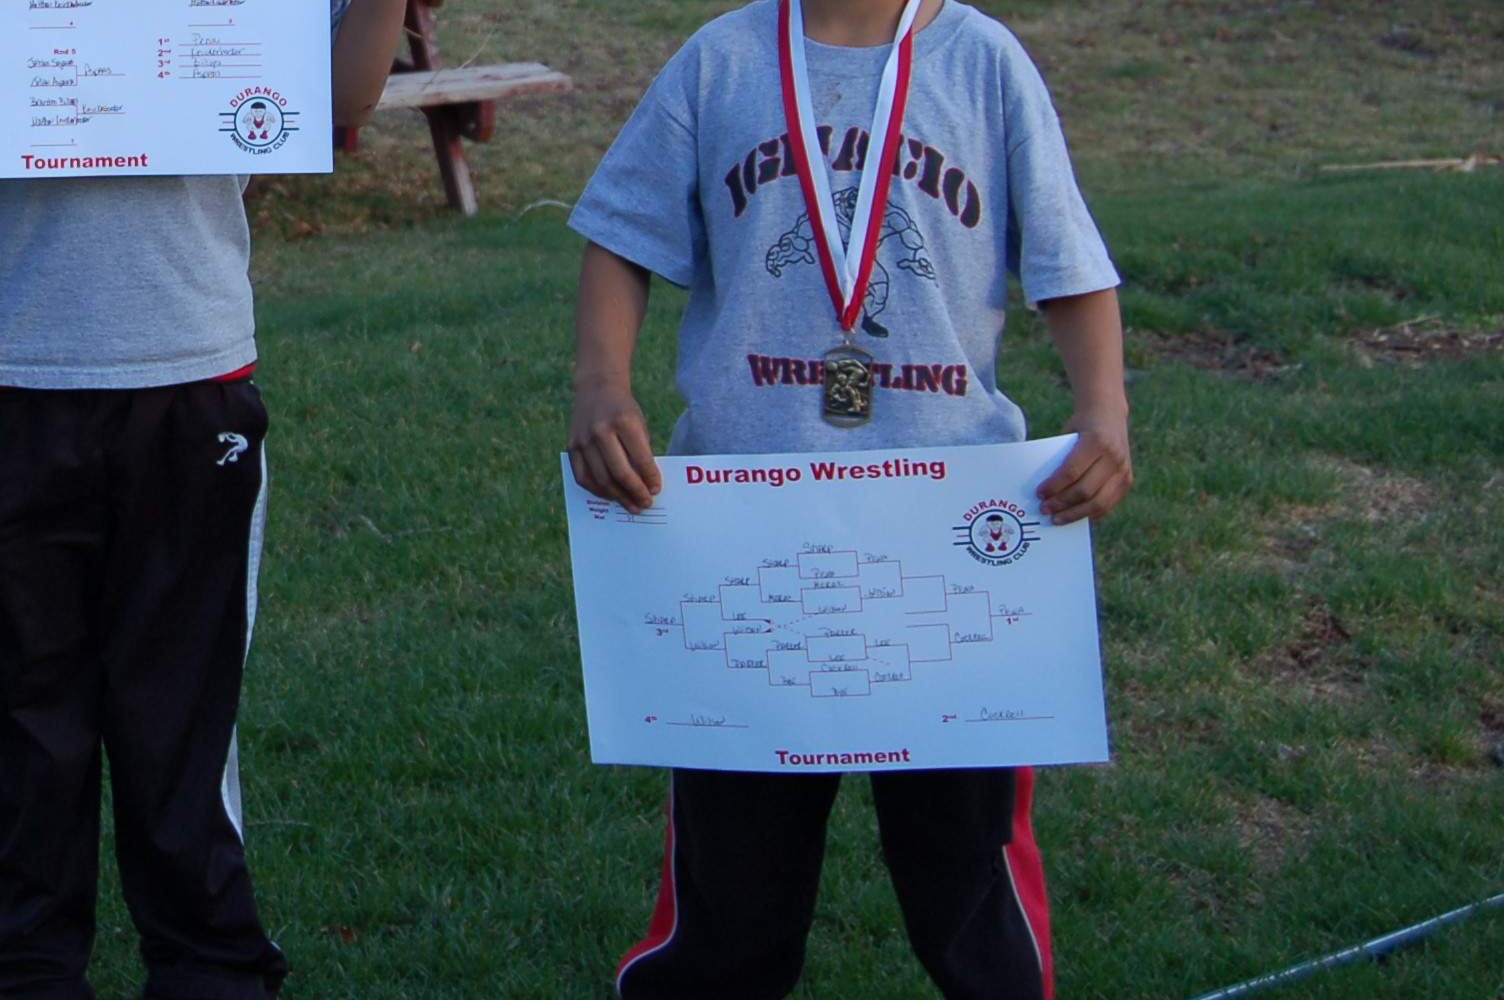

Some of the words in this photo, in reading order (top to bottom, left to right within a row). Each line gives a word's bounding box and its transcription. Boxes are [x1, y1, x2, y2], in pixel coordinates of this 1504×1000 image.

[229, 86, 287, 108] DURANGO
[272, 131, 290, 150] CLUB
[21, 153, 148, 169] Tournament
[747, 354, 968, 397] WRETLING
[686, 465, 802, 487] Durango
[810, 459, 945, 481] Wrestling
[963, 499, 1026, 521] DURANGO
[1012, 542, 1030, 561] CLUB
[774, 748, 911, 766] Tournament
